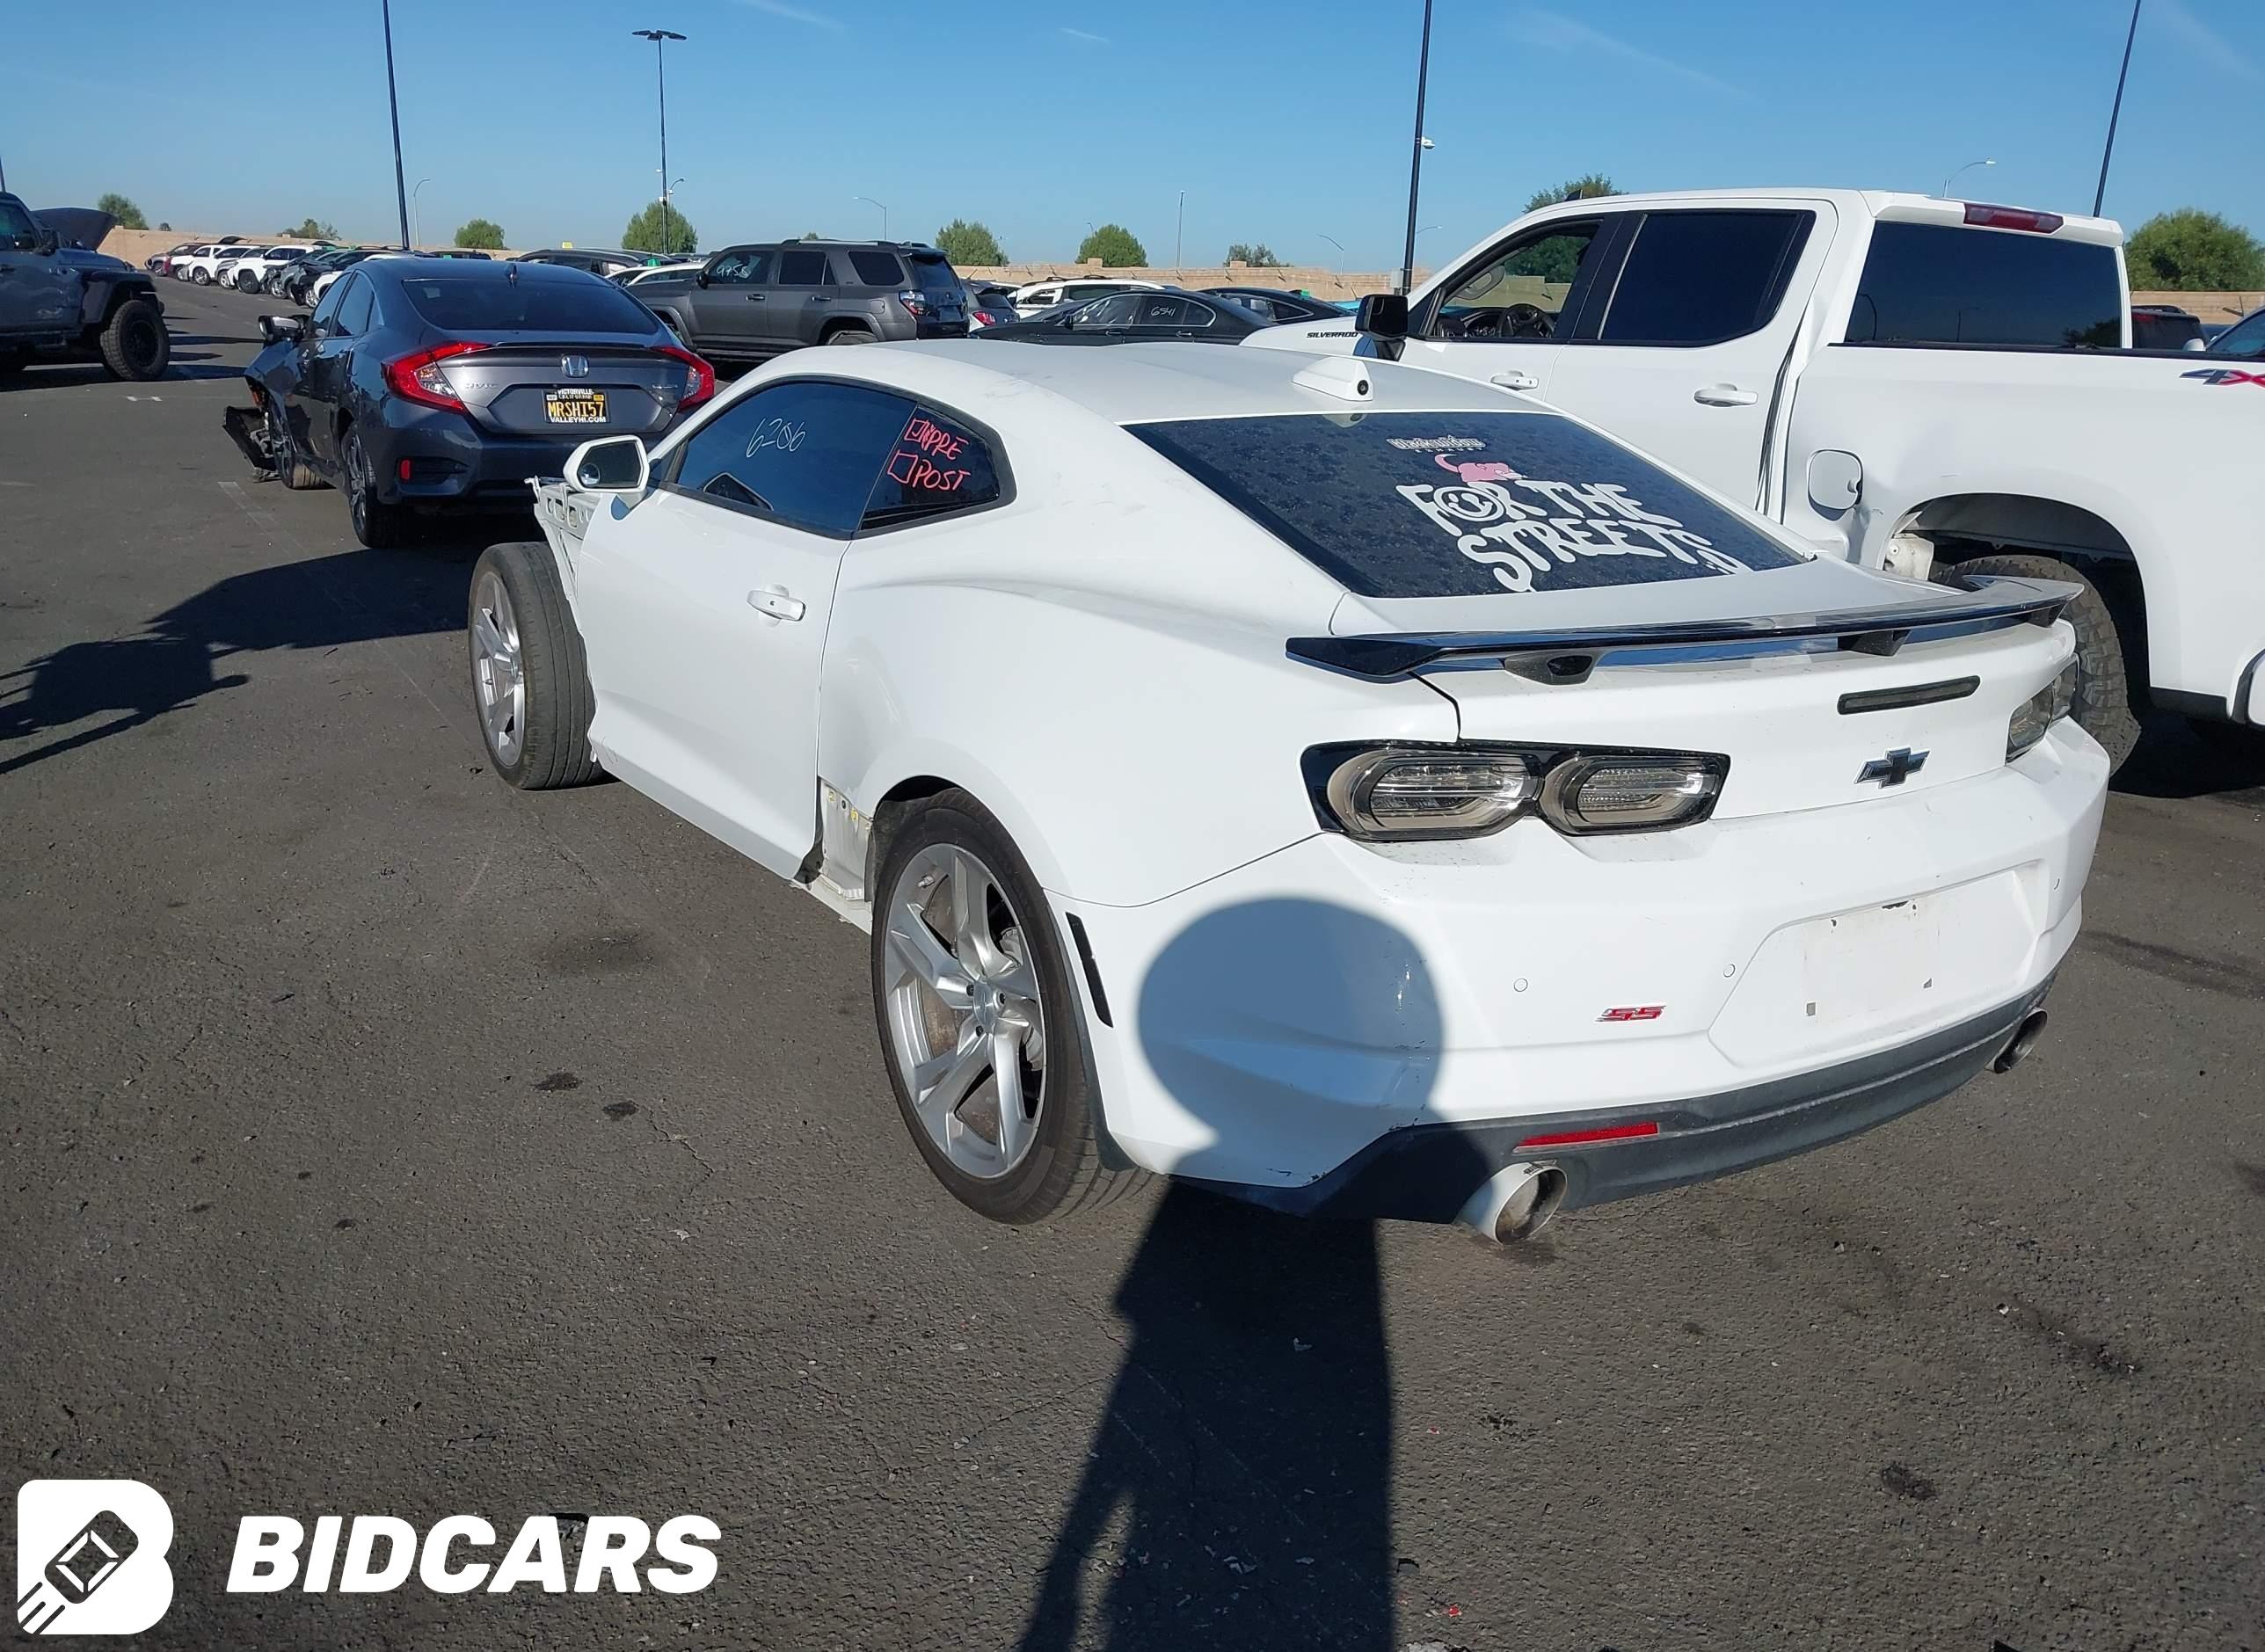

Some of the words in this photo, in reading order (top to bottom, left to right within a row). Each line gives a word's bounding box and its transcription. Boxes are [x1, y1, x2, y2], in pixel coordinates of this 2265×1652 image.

[548, 402, 604, 417] MRSHI57
[912, 459, 971, 491] POST
[1396, 481, 1548, 537] FOR
[1514, 480, 1683, 528] THE
[1457, 519, 1756, 593] STREETS
